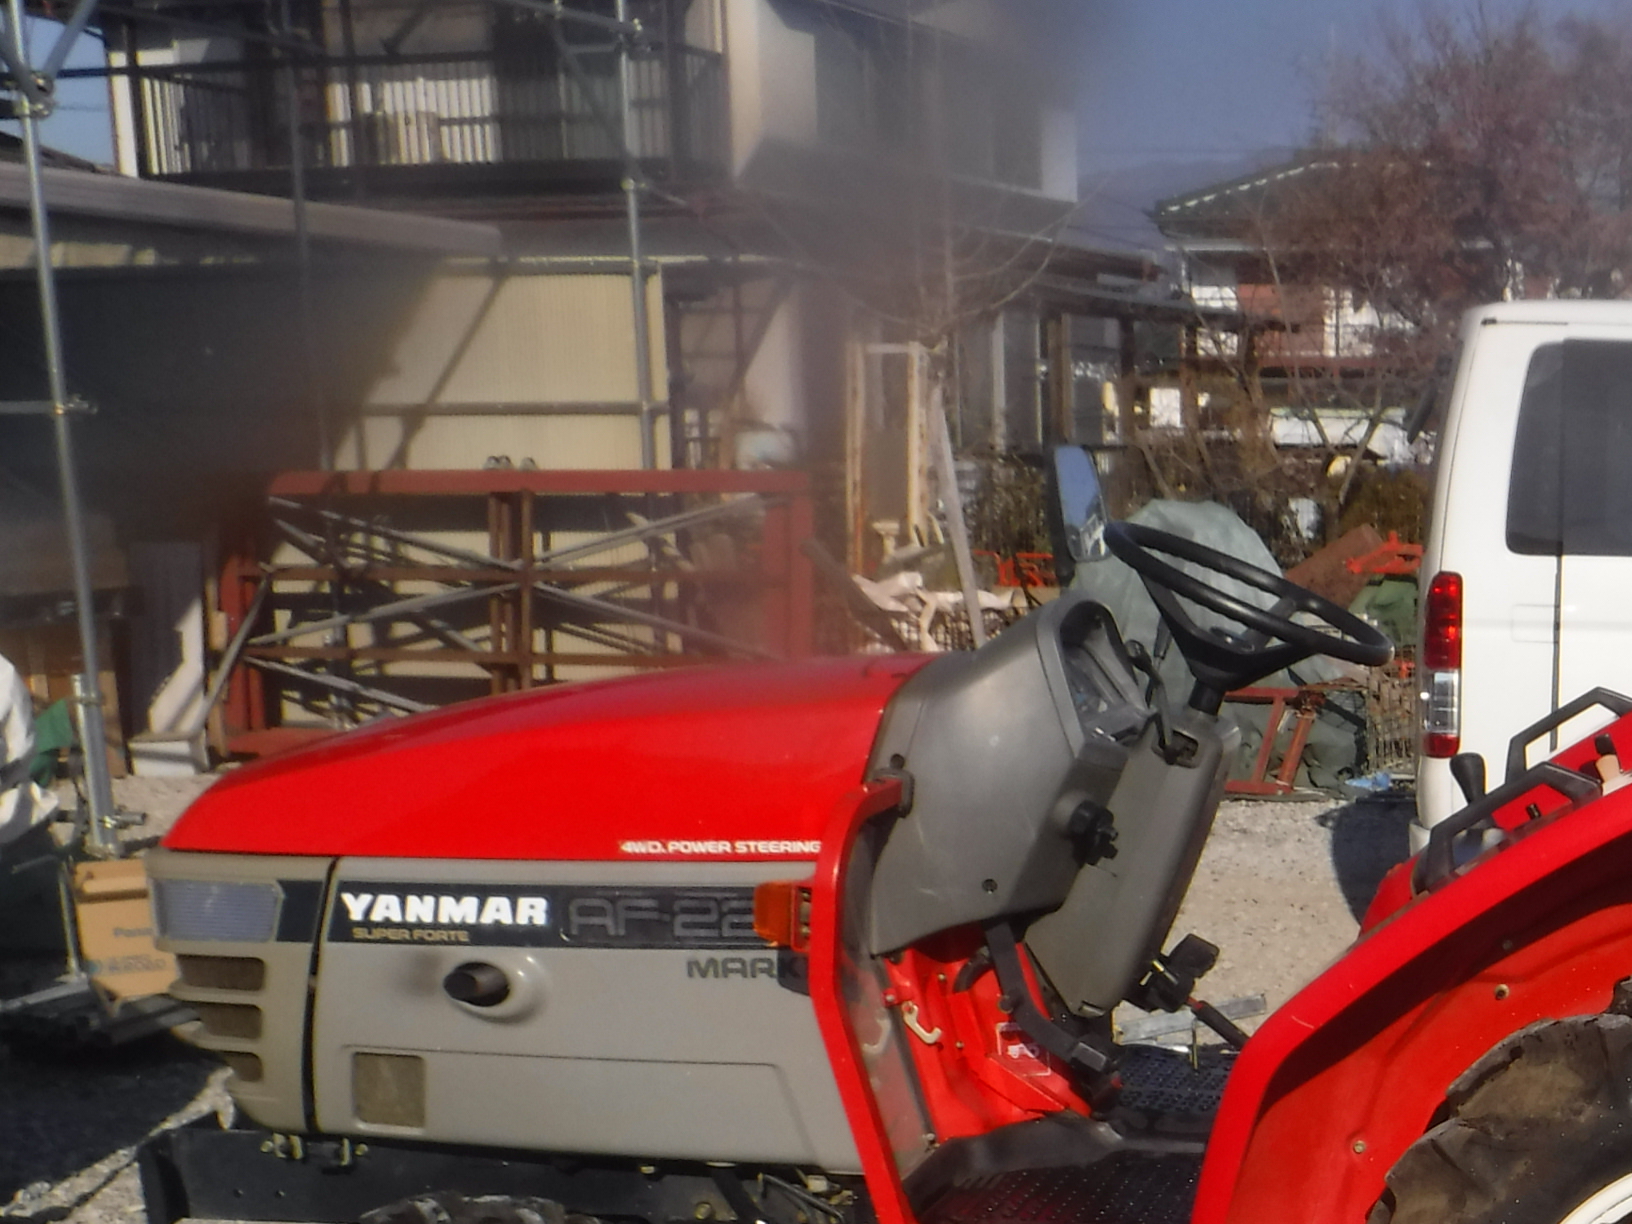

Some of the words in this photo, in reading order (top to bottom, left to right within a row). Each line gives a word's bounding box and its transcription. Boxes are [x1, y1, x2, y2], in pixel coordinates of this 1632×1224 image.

[668, 841, 730, 854] POWER
[734, 841, 821, 854] STEERING
[340, 892, 548, 925] YANMAR
[352, 927, 411, 940] SUPER
[412, 928, 471, 942] FORTE
